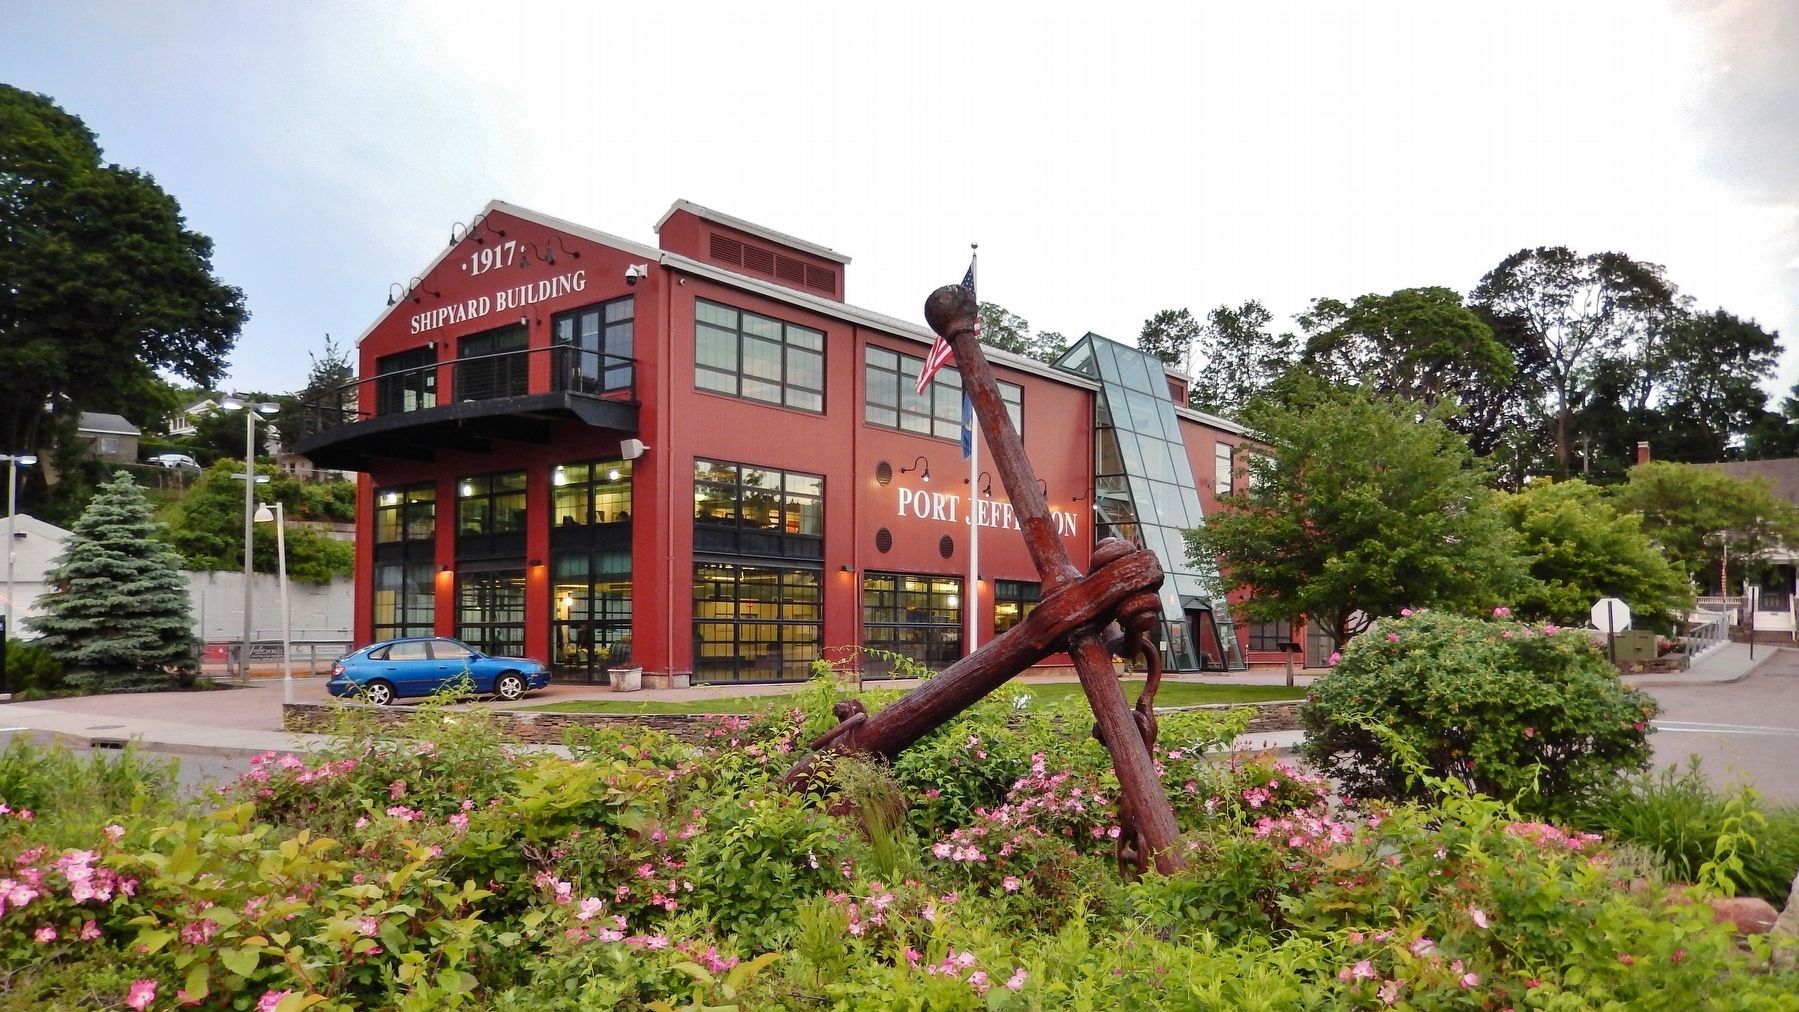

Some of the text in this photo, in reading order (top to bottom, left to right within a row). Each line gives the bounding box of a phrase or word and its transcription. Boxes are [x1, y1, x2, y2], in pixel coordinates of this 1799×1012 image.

[471, 240, 516, 276] 1917
[411, 270, 586, 335] SHIPYARD BUILDING
[897, 487, 1077, 537] PORT EFFON
